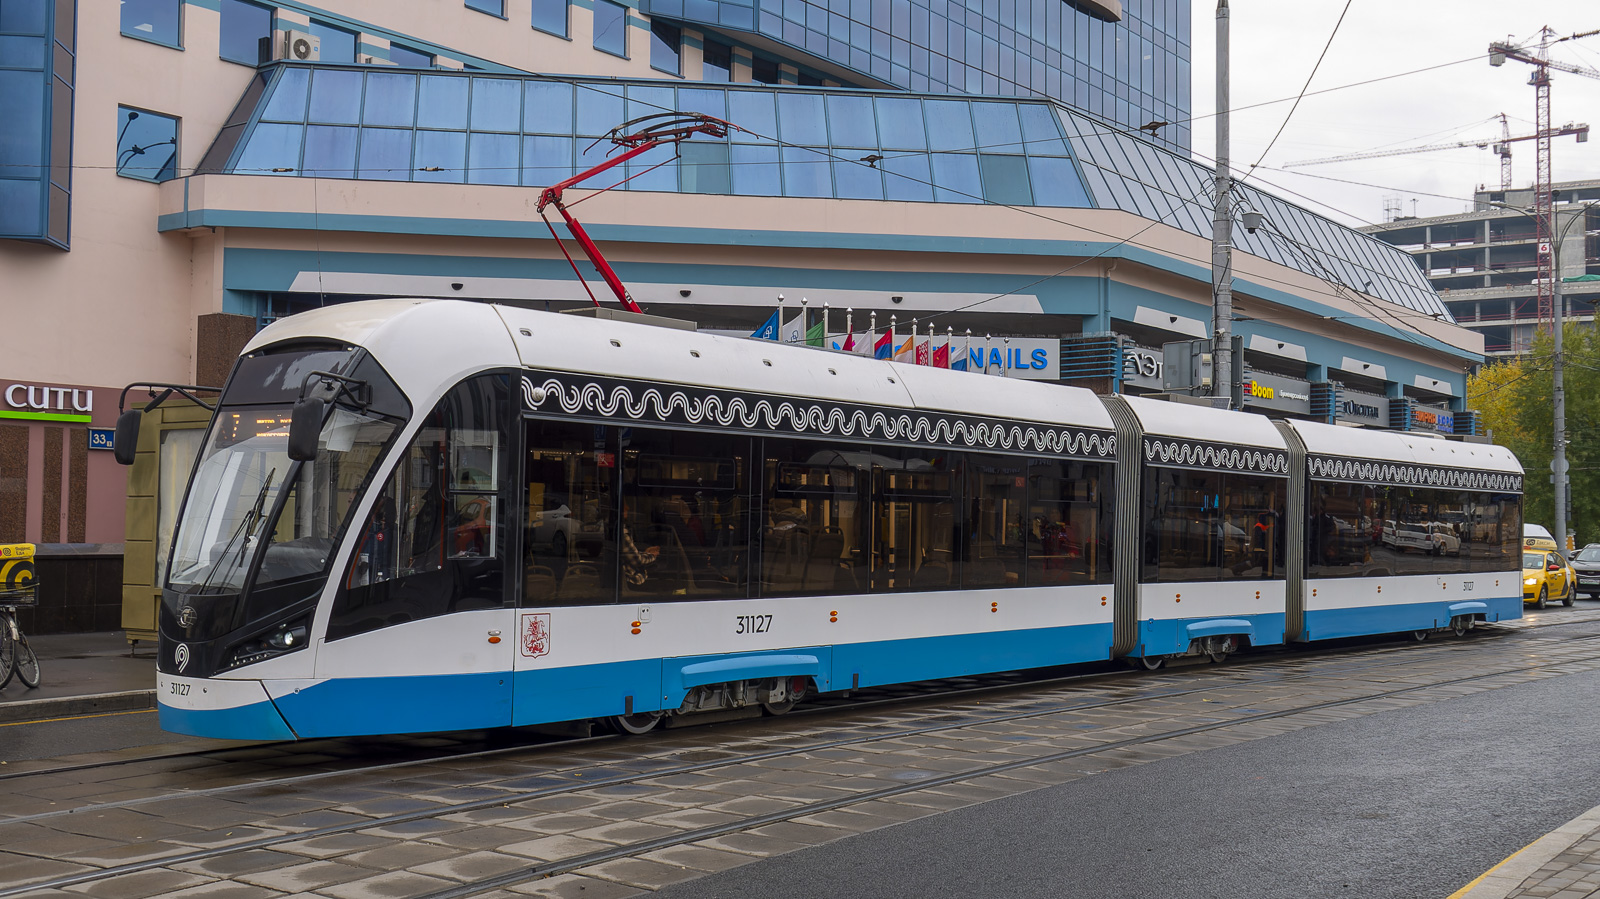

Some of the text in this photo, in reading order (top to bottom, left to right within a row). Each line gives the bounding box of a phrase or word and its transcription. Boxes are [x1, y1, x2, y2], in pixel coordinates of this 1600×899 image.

[969, 347, 1048, 371] NAILS
[93, 433, 106, 445] 33
[736, 614, 773, 635] 31127
[170, 682, 191, 696] 31127
